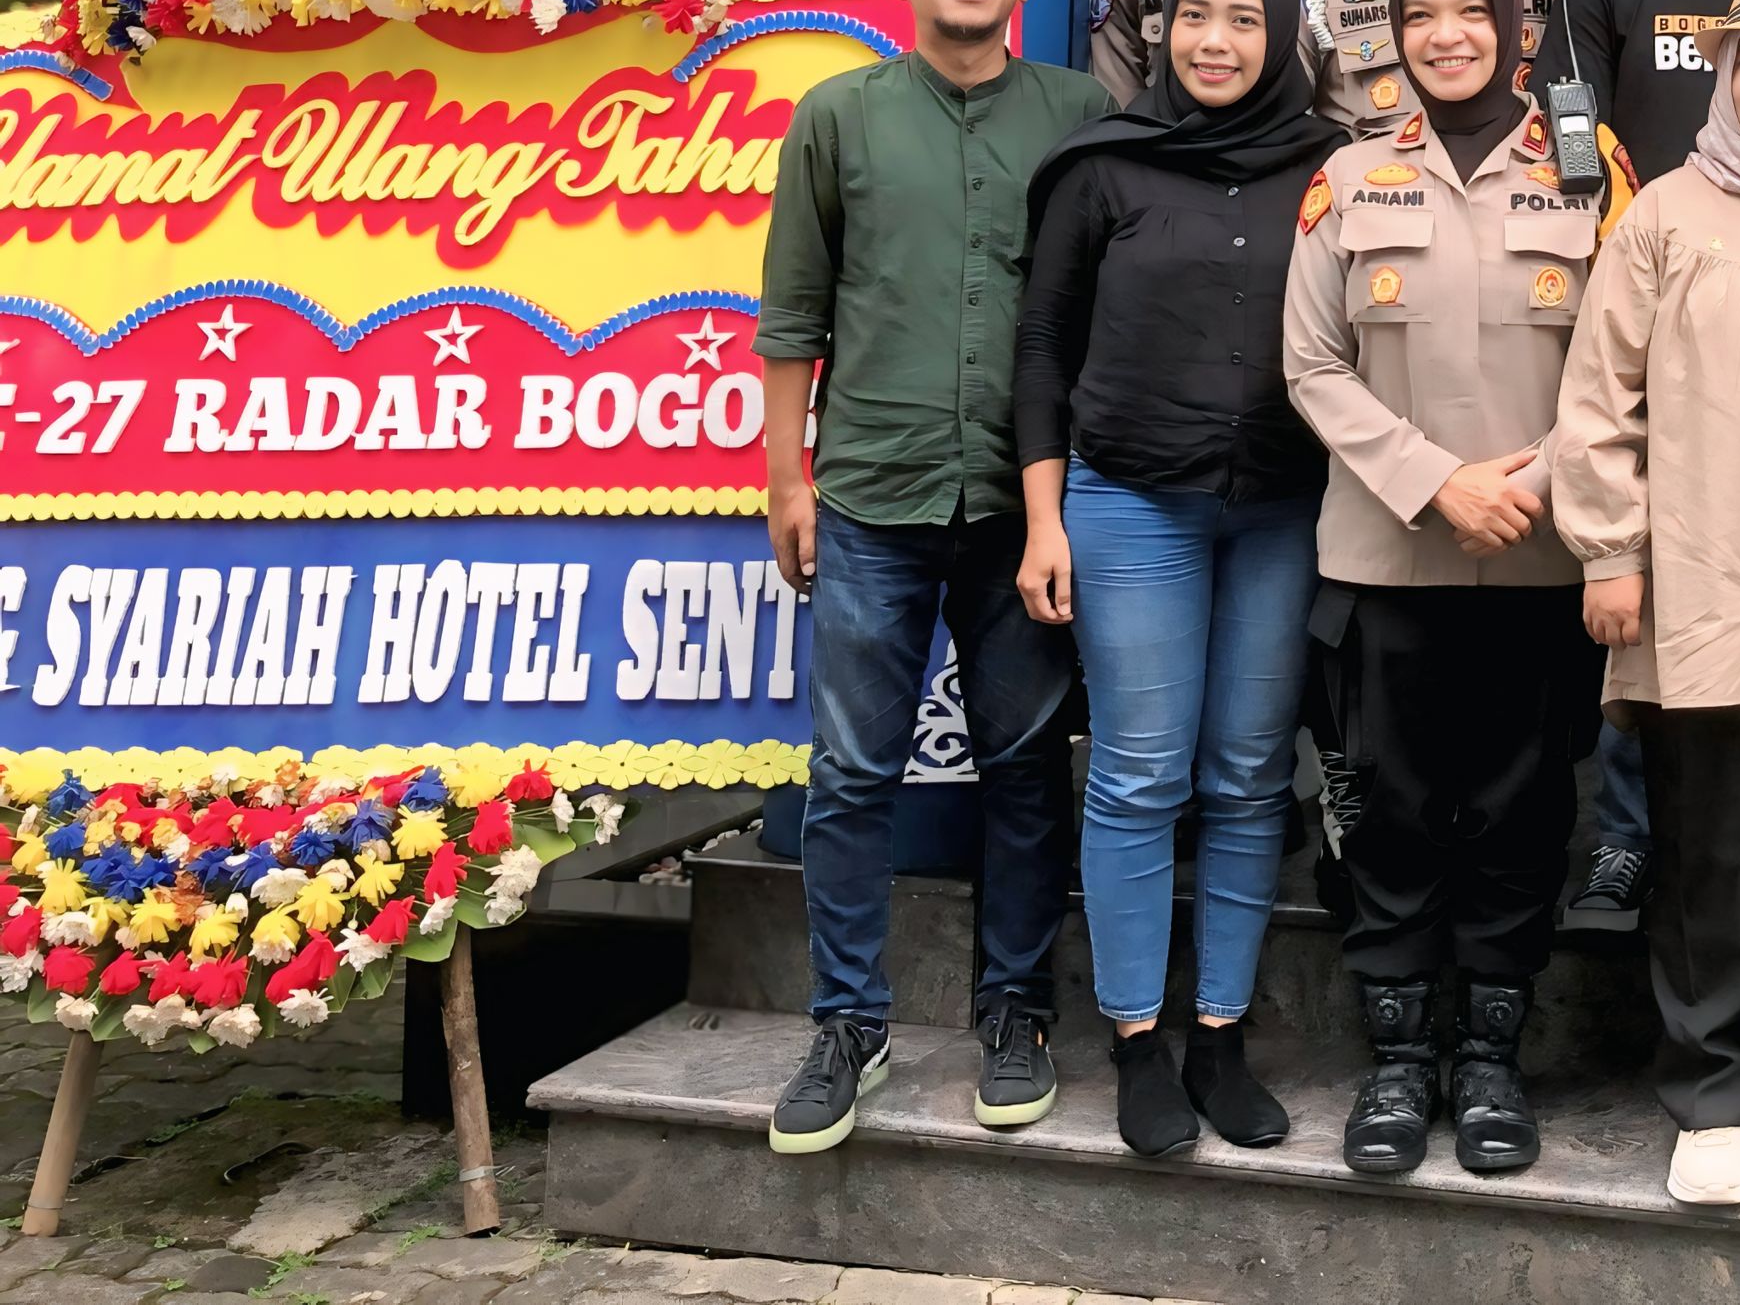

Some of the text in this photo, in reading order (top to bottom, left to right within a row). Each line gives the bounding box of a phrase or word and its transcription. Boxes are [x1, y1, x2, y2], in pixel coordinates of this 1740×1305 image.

[261, 98, 570, 247] Ulang
[1352, 189, 1425, 207] ARIANI
[1510, 192, 1590, 211] POLRI
[164, 375, 491, 453] RADAR
[31, 563, 357, 707] SYARIAH
[358, 559, 592, 705] HOTEL
